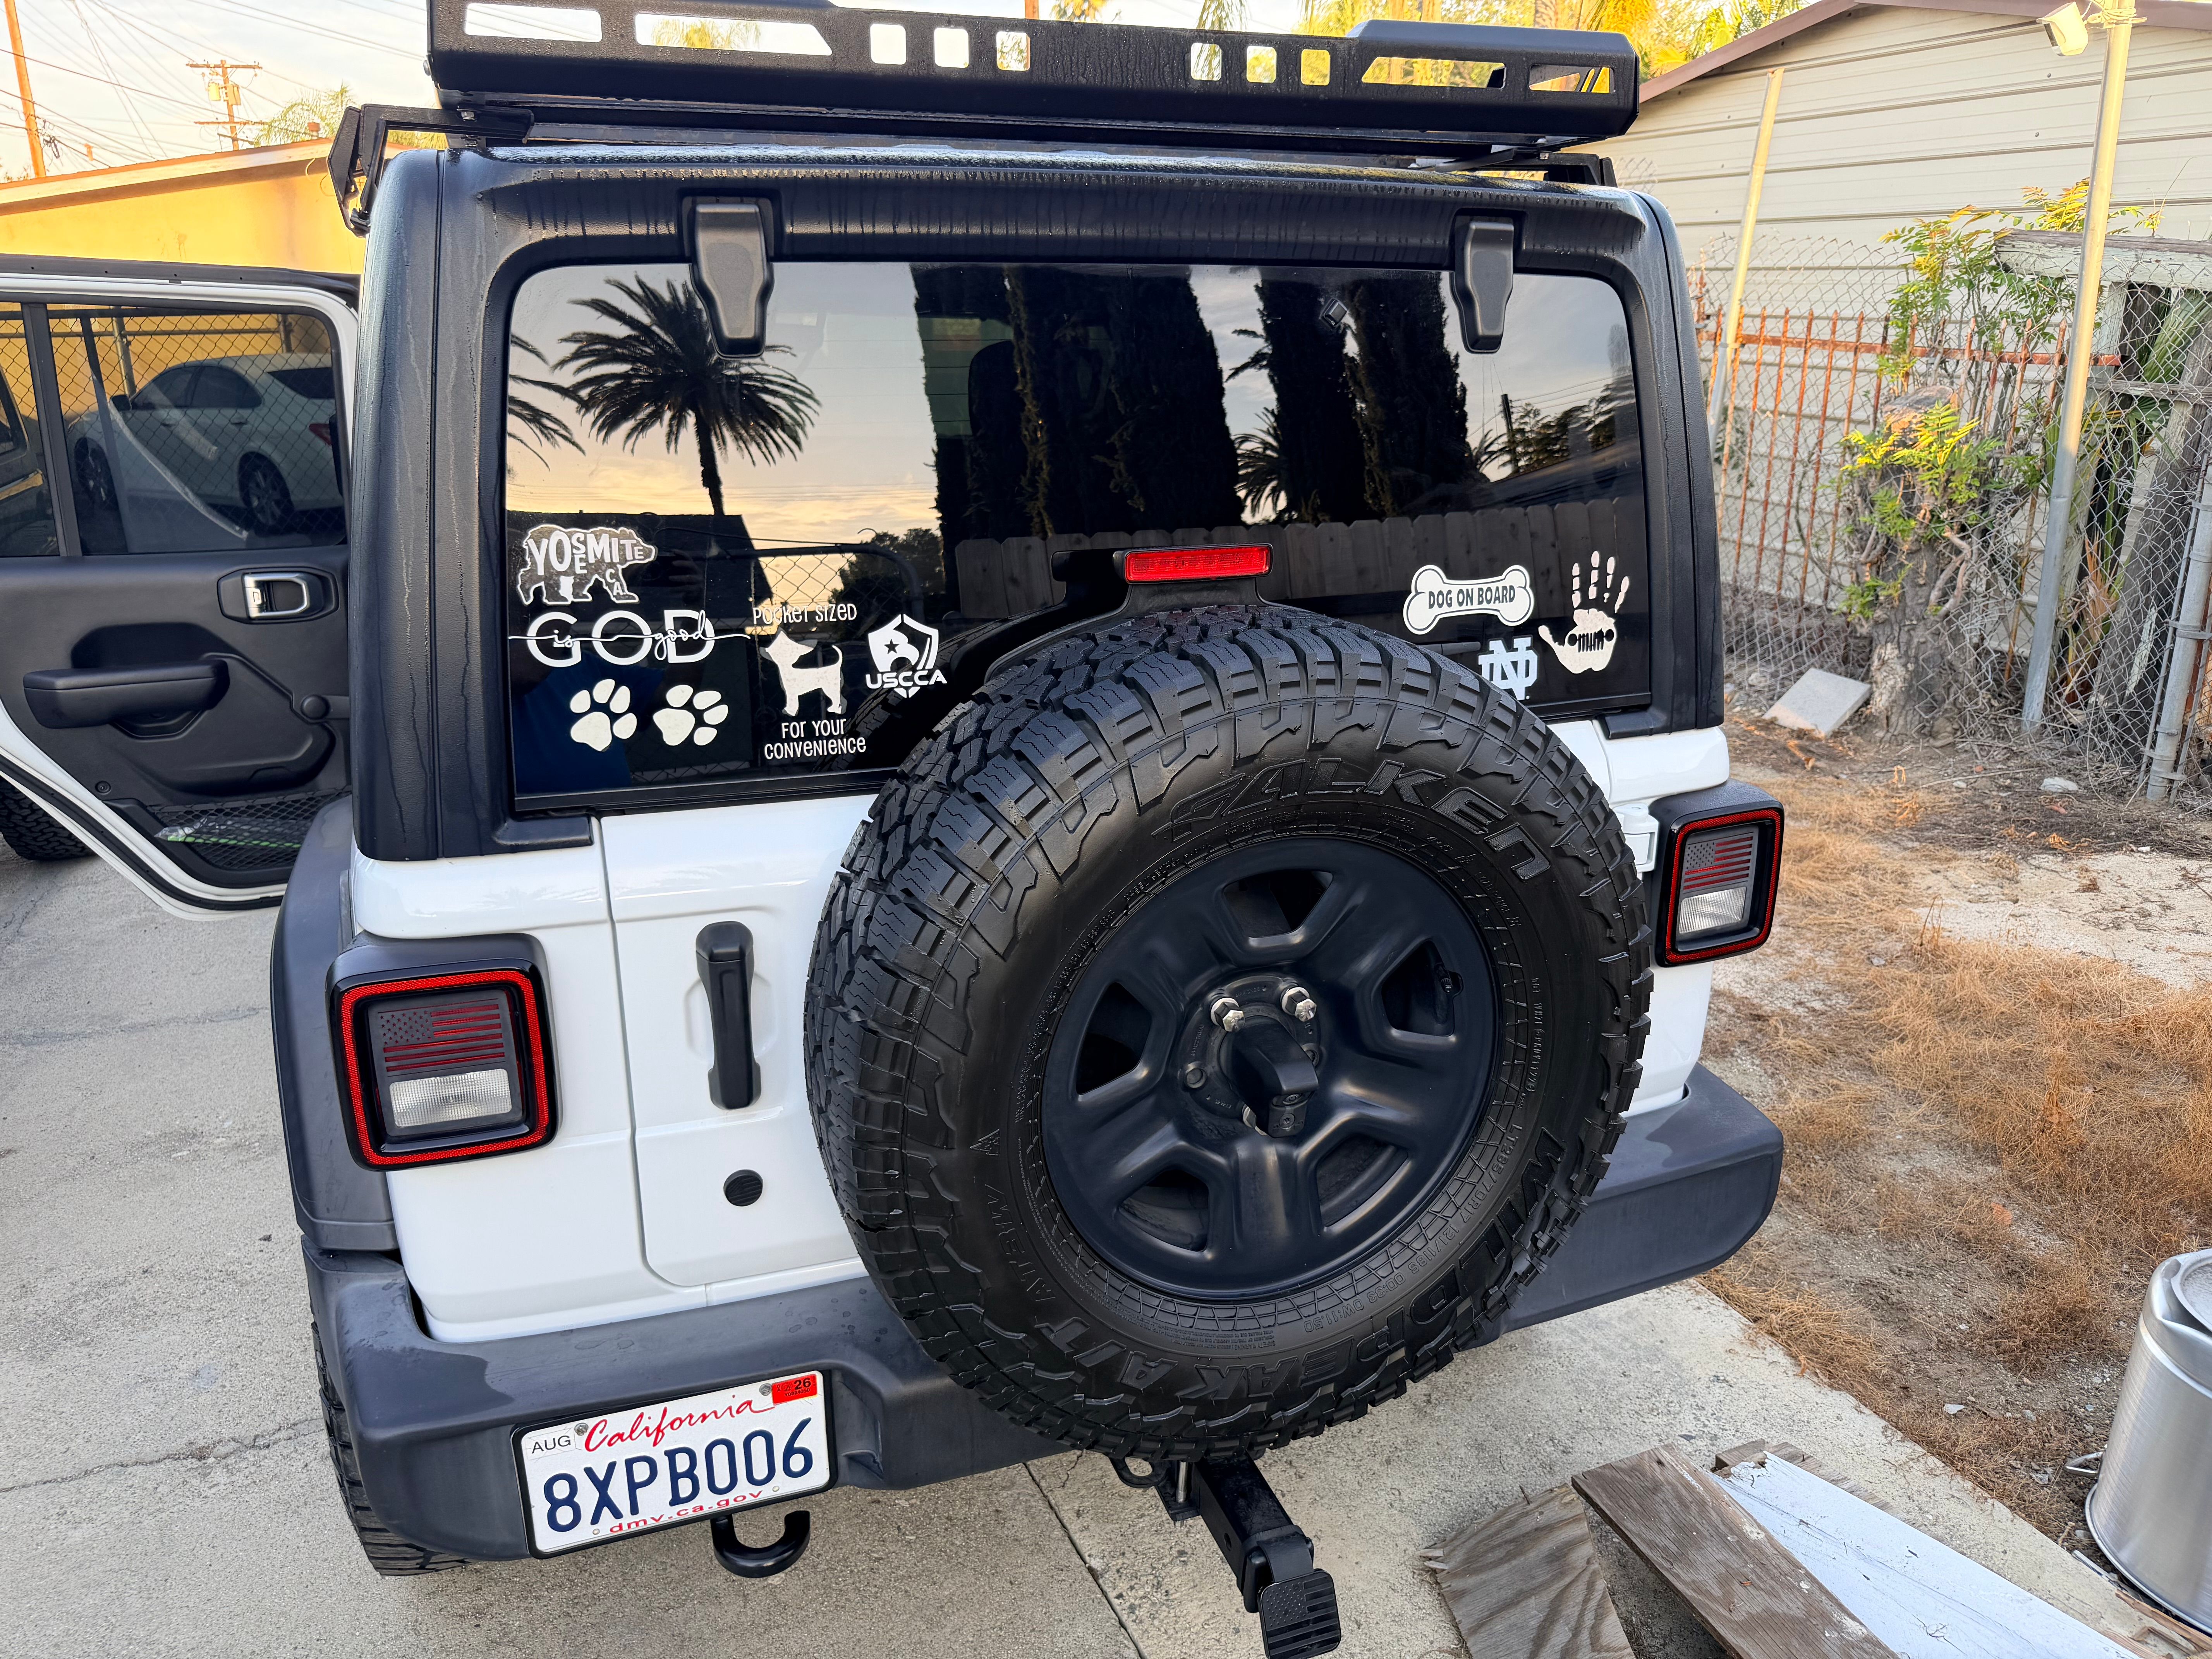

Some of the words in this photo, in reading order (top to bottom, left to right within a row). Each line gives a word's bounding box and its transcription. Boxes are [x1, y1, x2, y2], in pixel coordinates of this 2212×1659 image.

[1428, 589, 1453, 610] DOG
[1456, 587, 1475, 608] ON
[1477, 584, 1516, 605] BOARD
[526, 610, 716, 668] GOD
[654, 610, 709, 661] good
[866, 669, 948, 689] USCCA
[1152, 757, 1550, 880] FALKEN
[1462, 1124, 1523, 1223] LT285/70R17
[1175, 1127, 1566, 1400] WILDPEAK
[1407, 1223, 1460, 1274] 121/118S
[1367, 1271, 1406, 1304] OD:33
[1303, 1297, 1365, 1333] OW:11.50
[794, 1377, 811, 1390] 26
[531, 1435, 571, 1455] AUG
[584, 1395, 776, 1453] California
[543, 1416, 814, 1532] 8XPB006
[609, 1489, 763, 1534] dmv.ca.gov
